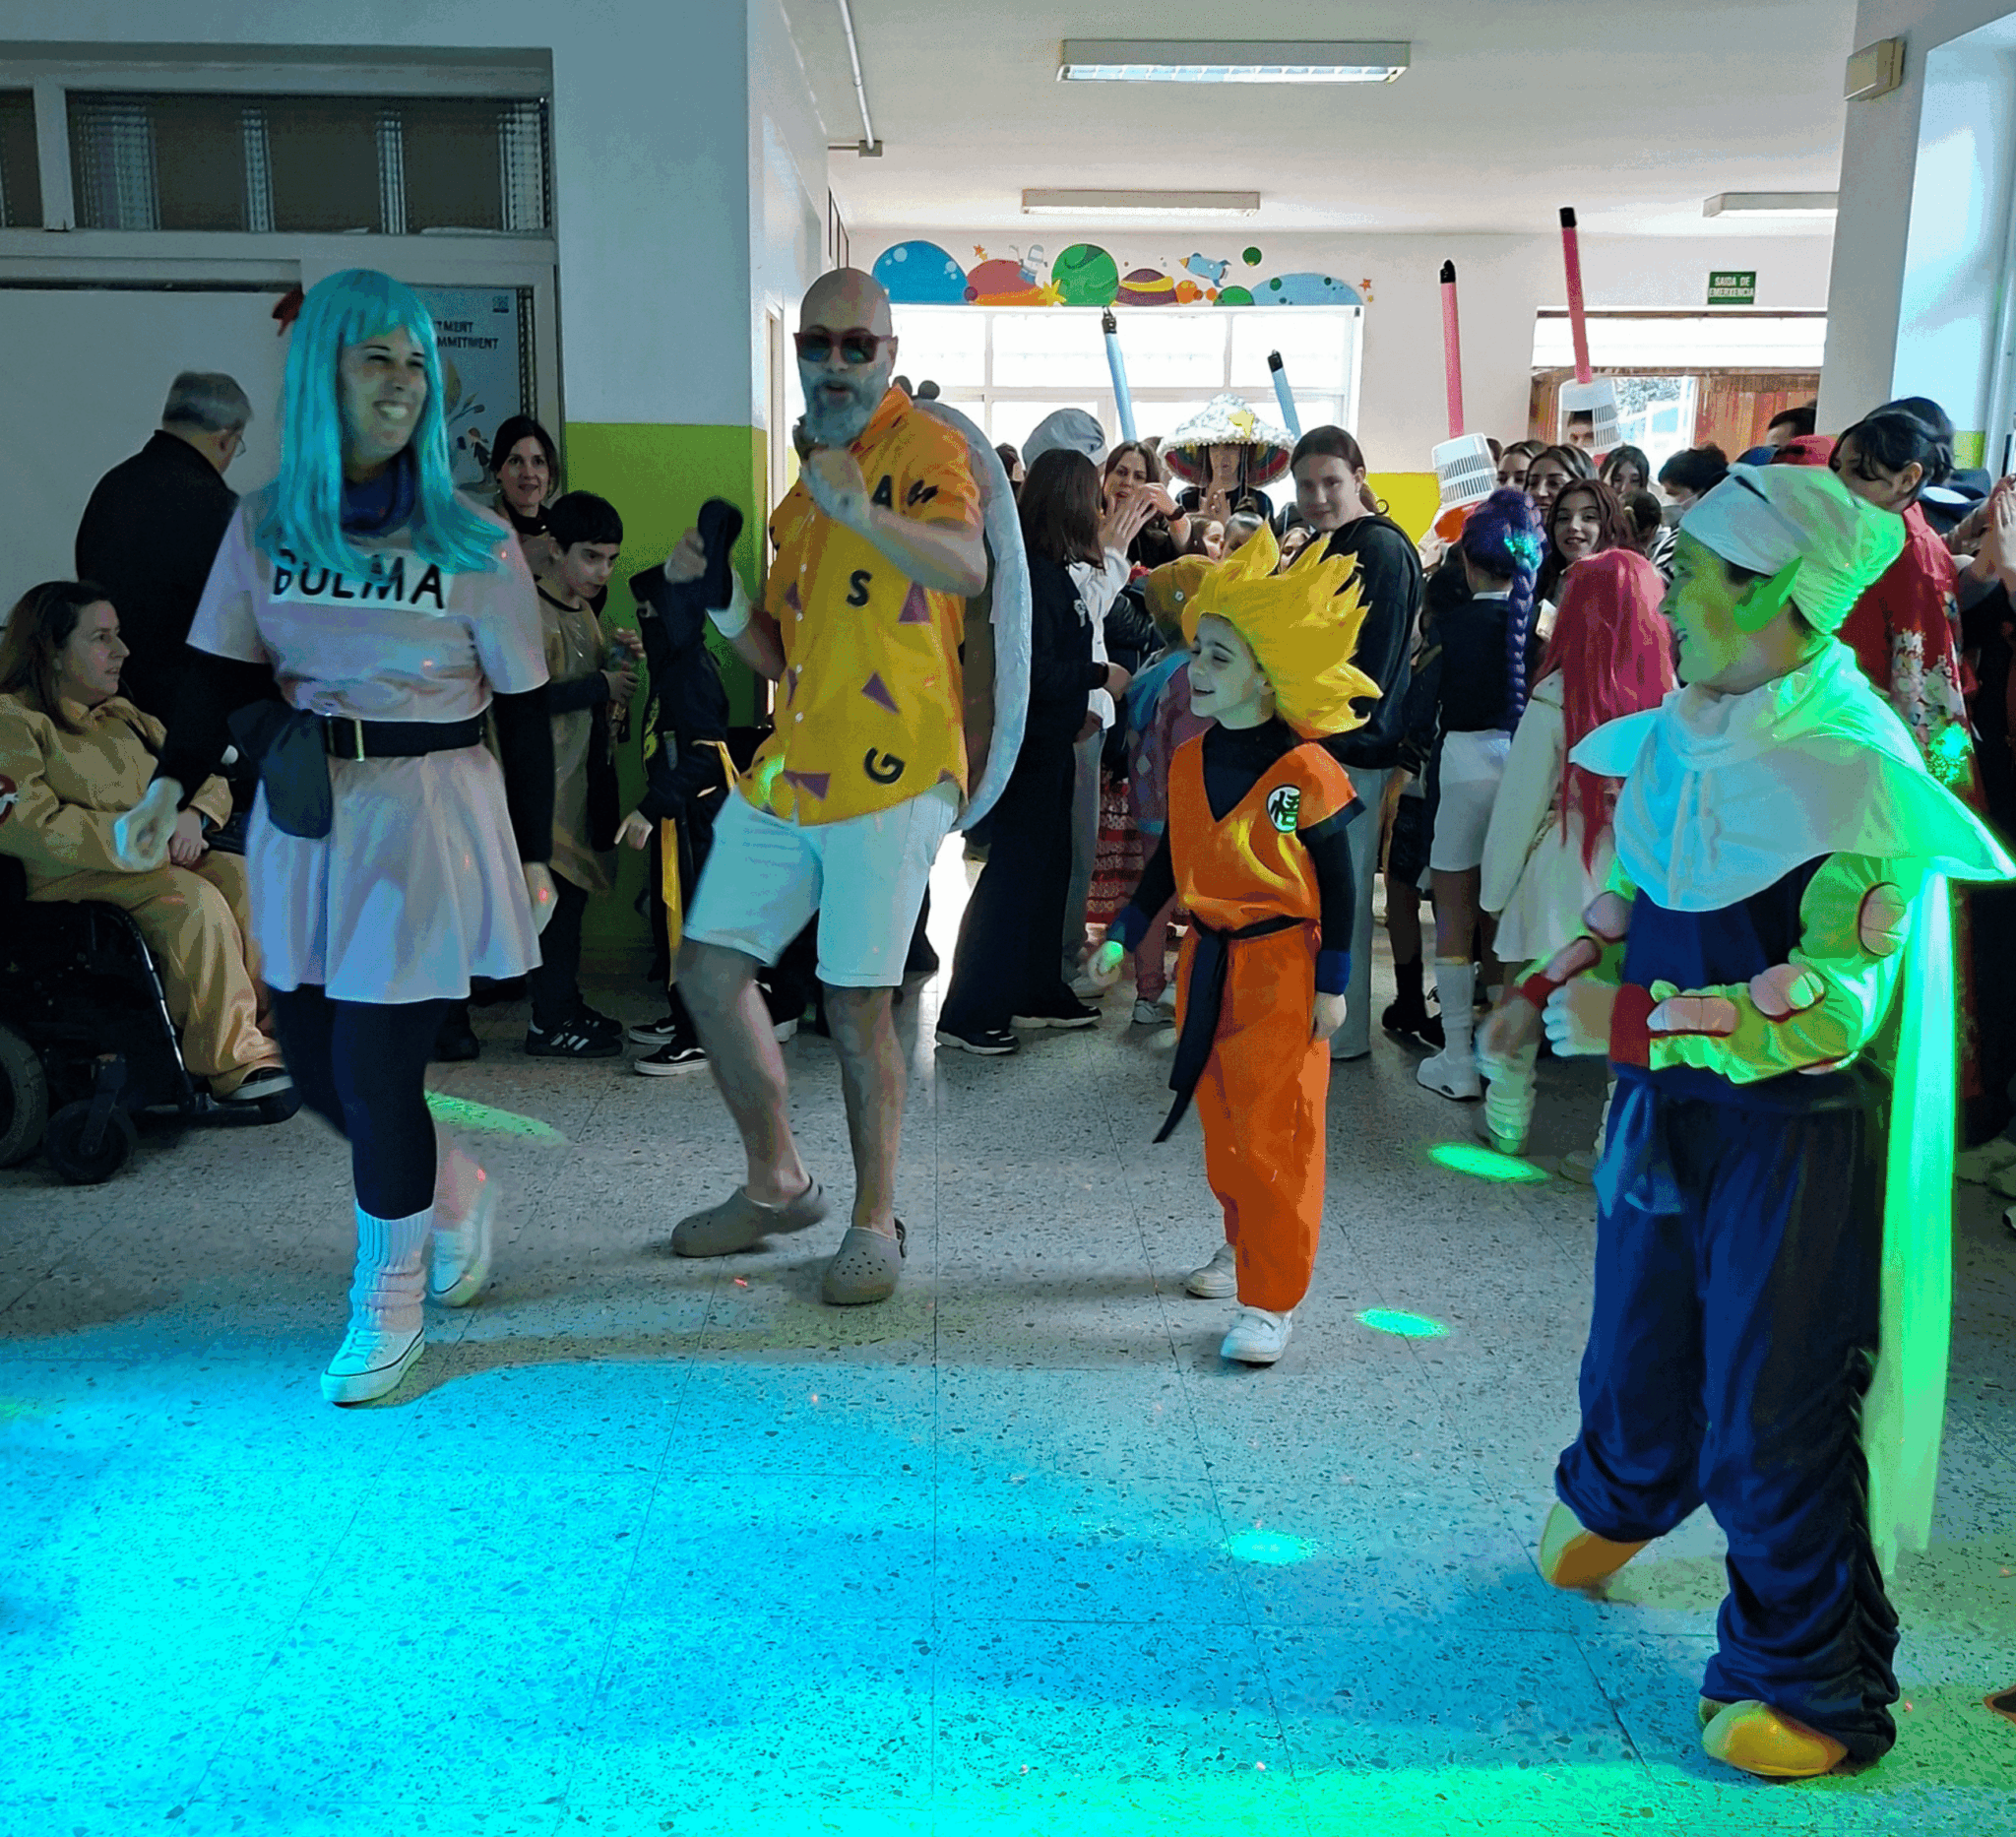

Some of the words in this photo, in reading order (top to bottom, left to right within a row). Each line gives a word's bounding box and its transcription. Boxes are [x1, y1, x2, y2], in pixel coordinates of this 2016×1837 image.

[434, 320, 473, 333] TMENT
[437, 336, 499, 349] MMITMENT
[846, 569, 873, 607] S
[862, 746, 906, 785] G
